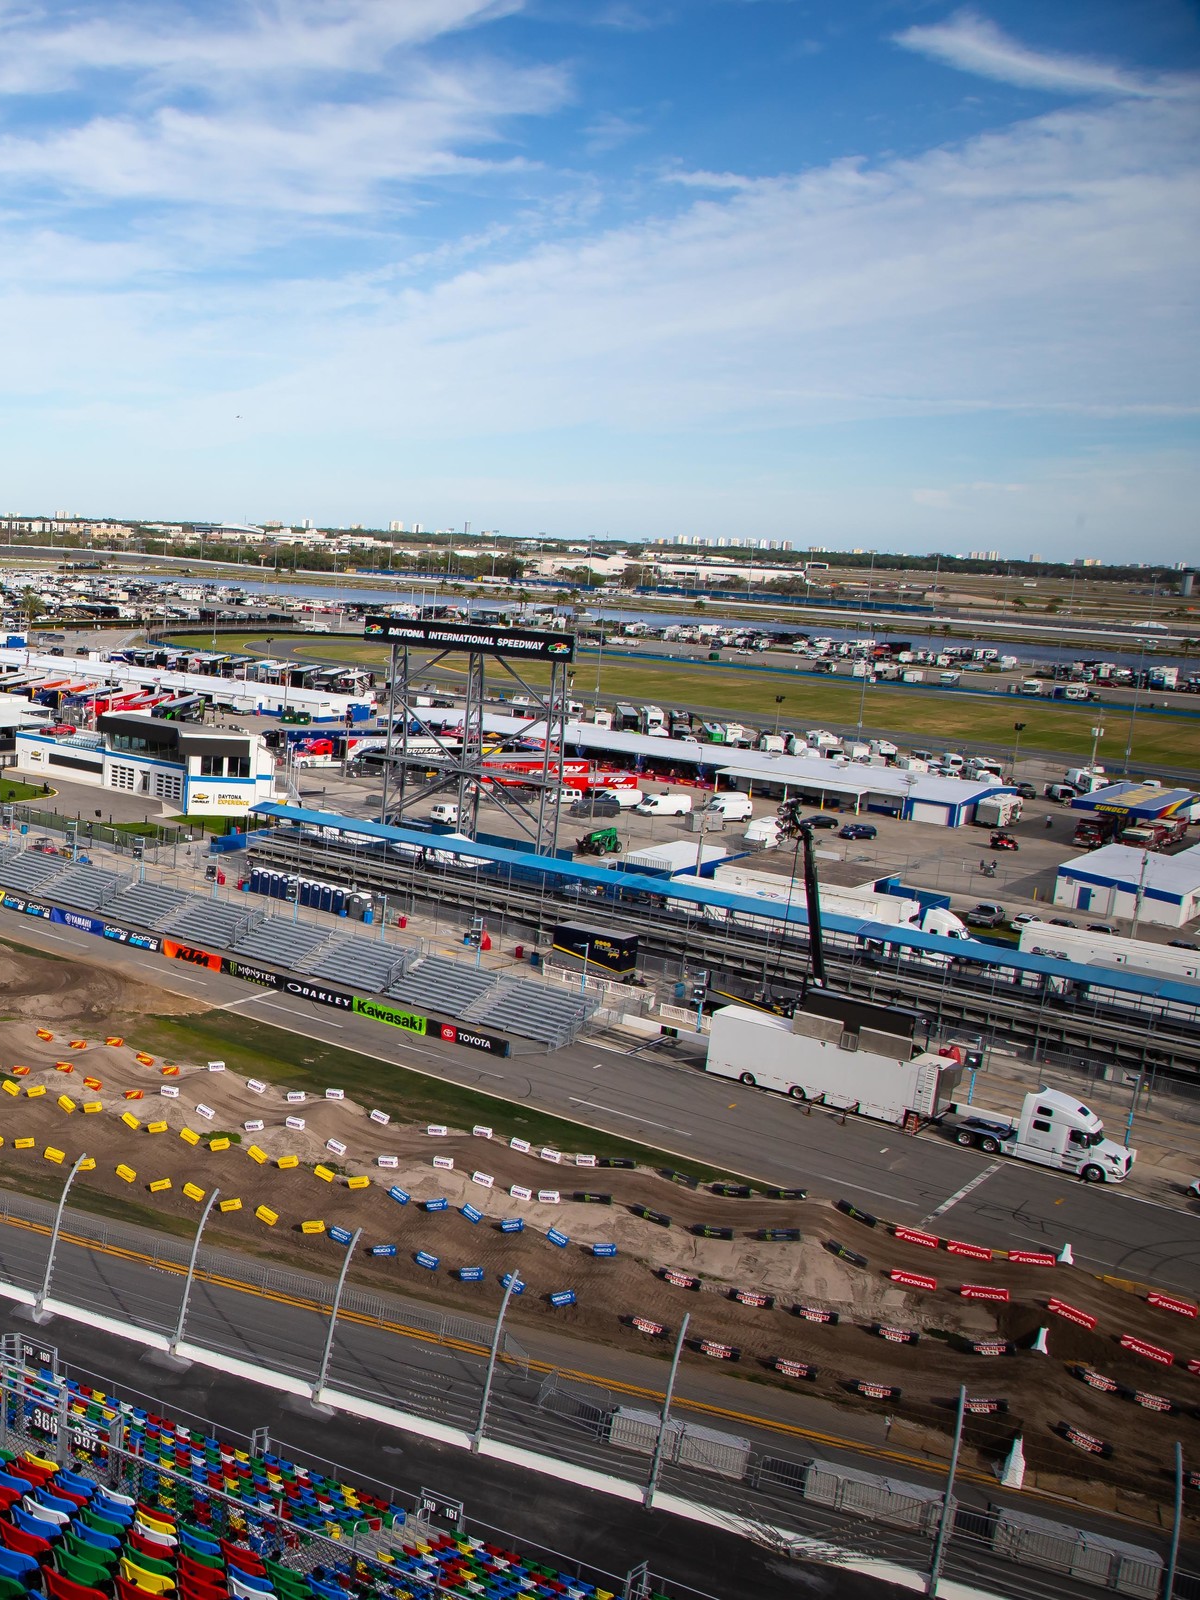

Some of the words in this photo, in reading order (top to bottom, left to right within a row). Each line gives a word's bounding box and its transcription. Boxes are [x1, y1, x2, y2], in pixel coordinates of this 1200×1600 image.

[388, 627, 425, 639] DAYTONA
[428, 631, 494, 646] INTERNATIONAL
[497, 638, 544, 650] SPEEDWAY
[1094, 804, 1129, 814] SUNOCO
[5, 895, 25, 906] GoPro
[28, 902, 50, 913] GoPro
[72, 915, 92, 929] YAMAHA
[105, 925, 128, 936] GoPro
[132, 933, 158, 946] GoPro
[594, 945, 620, 954] musco
[175, 948, 209, 968] KTM
[238, 964, 276, 983] MONSTER
[243, 976, 270, 987] ENERGY
[303, 987, 350, 1007] OAKLEY
[357, 1000, 423, 1032] Kawasaki
[458, 1032, 491, 1049] TOYOTA
[391, 1189, 406, 1200] GEICO
[463, 1209, 480, 1221] GEICO
[332, 1230, 348, 1240] GEICO
[549, 1232, 566, 1244] GEICO
[904, 1234, 936, 1248] HONDA
[956, 1249, 988, 1260] HONDA
[417, 1256, 435, 1266] GEICO
[1018, 1257, 1053, 1267] HONDA
[665, 1274, 692, 1287] DISCOUNT
[900, 1277, 934, 1290] HONDA
[737, 1295, 765, 1305] DISCOUNT
[970, 1292, 1006, 1301] HONDA
[1158, 1301, 1194, 1317] HONDA
[800, 1310, 830, 1321] DISCOUNT
[1057, 1309, 1093, 1329] HONDA
[632, 1319, 662, 1334] DISCOUNT
[879, 1329, 910, 1341] DISCOUNT
[24, 1345, 33, 1356] 159
[702, 1346, 730, 1357] DISCOUNT
[973, 1345, 1006, 1353] DISCOUNT
[1131, 1345, 1168, 1364] HONDA
[40, 1352, 50, 1363] 160
[775, 1363, 806, 1376] DISCOUNT
[1083, 1374, 1117, 1391] DISCOUNT
[858, 1384, 891, 1396] DISCOUNT
[1135, 1395, 1171, 1410] DISCOUNT
[34, 1408, 57, 1435] 366
[1067, 1432, 1102, 1453] DISCOUNT
[423, 1500, 436, 1511] 160
[445, 1509, 458, 1520] 161
